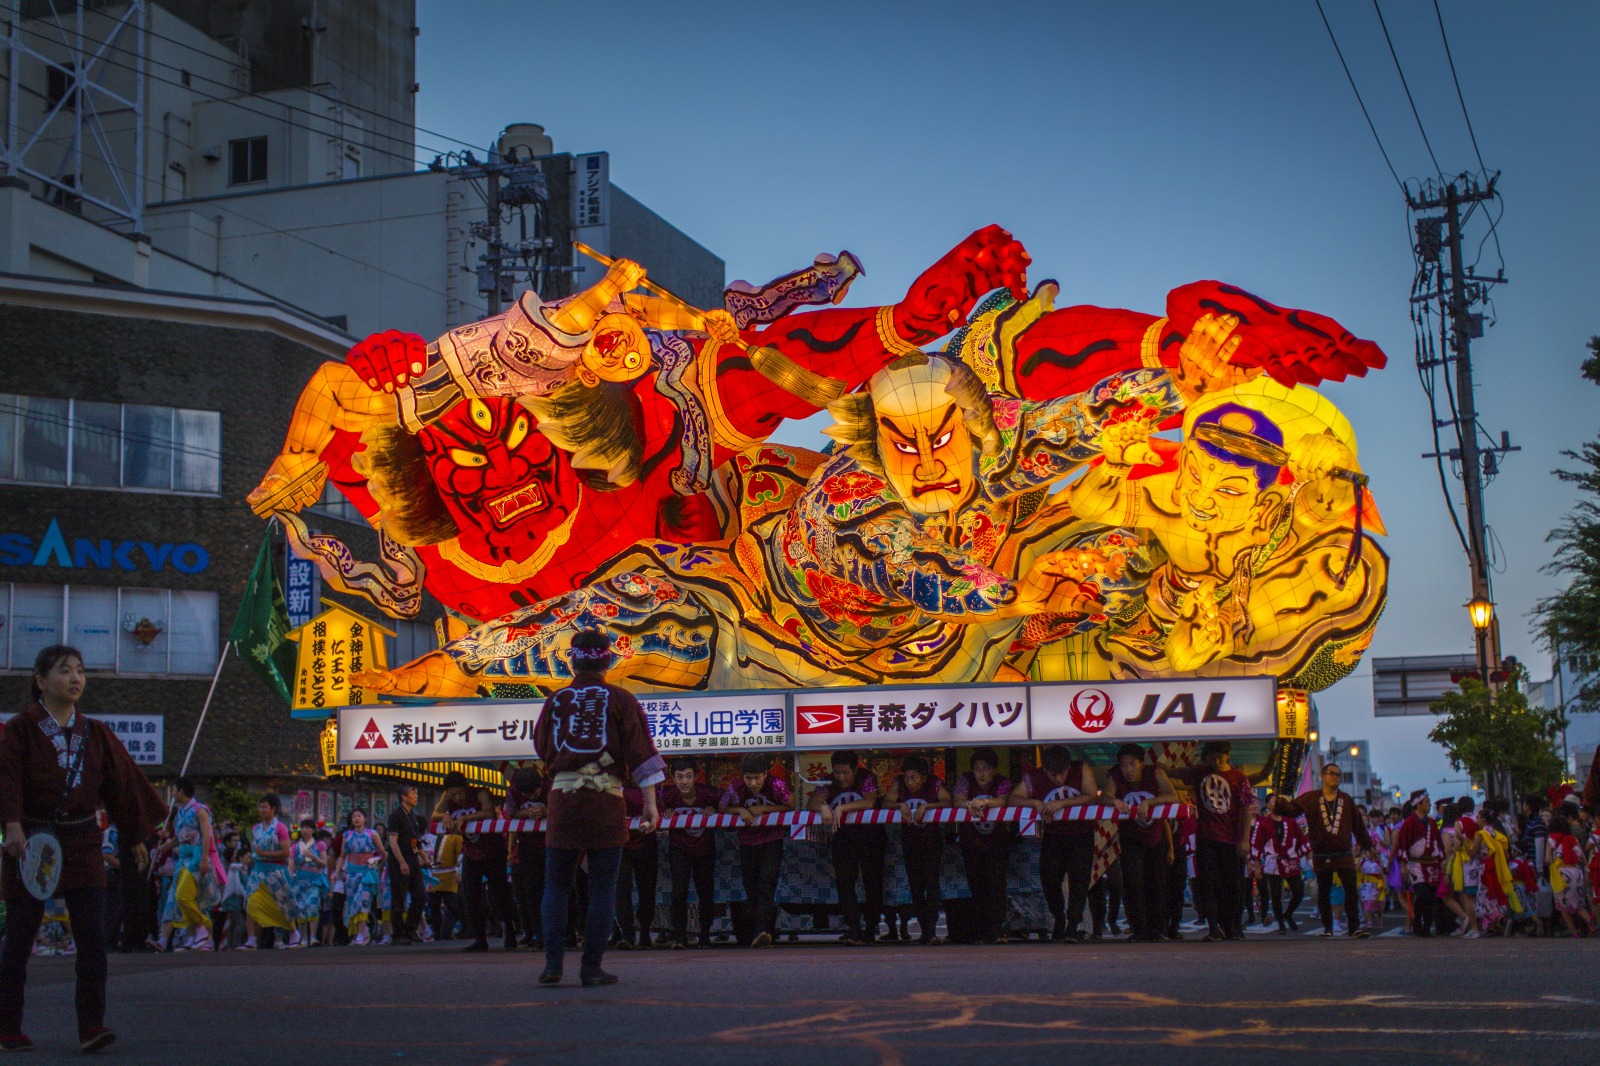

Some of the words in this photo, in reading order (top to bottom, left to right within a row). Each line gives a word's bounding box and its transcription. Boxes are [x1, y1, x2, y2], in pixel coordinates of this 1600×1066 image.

[0, 516, 210, 574] SANKYO
[311, 621, 327, 707] 相撲をとる
[331, 639, 345, 691] 仁王と
[348, 621, 364, 706] 金神長郎
[846, 702, 1023, 733] 青森ダイハツ
[1081, 720, 1106, 729] JAL
[1124, 692, 1237, 726] JAL
[392, 719, 535, 745] 森山ディーゼル
